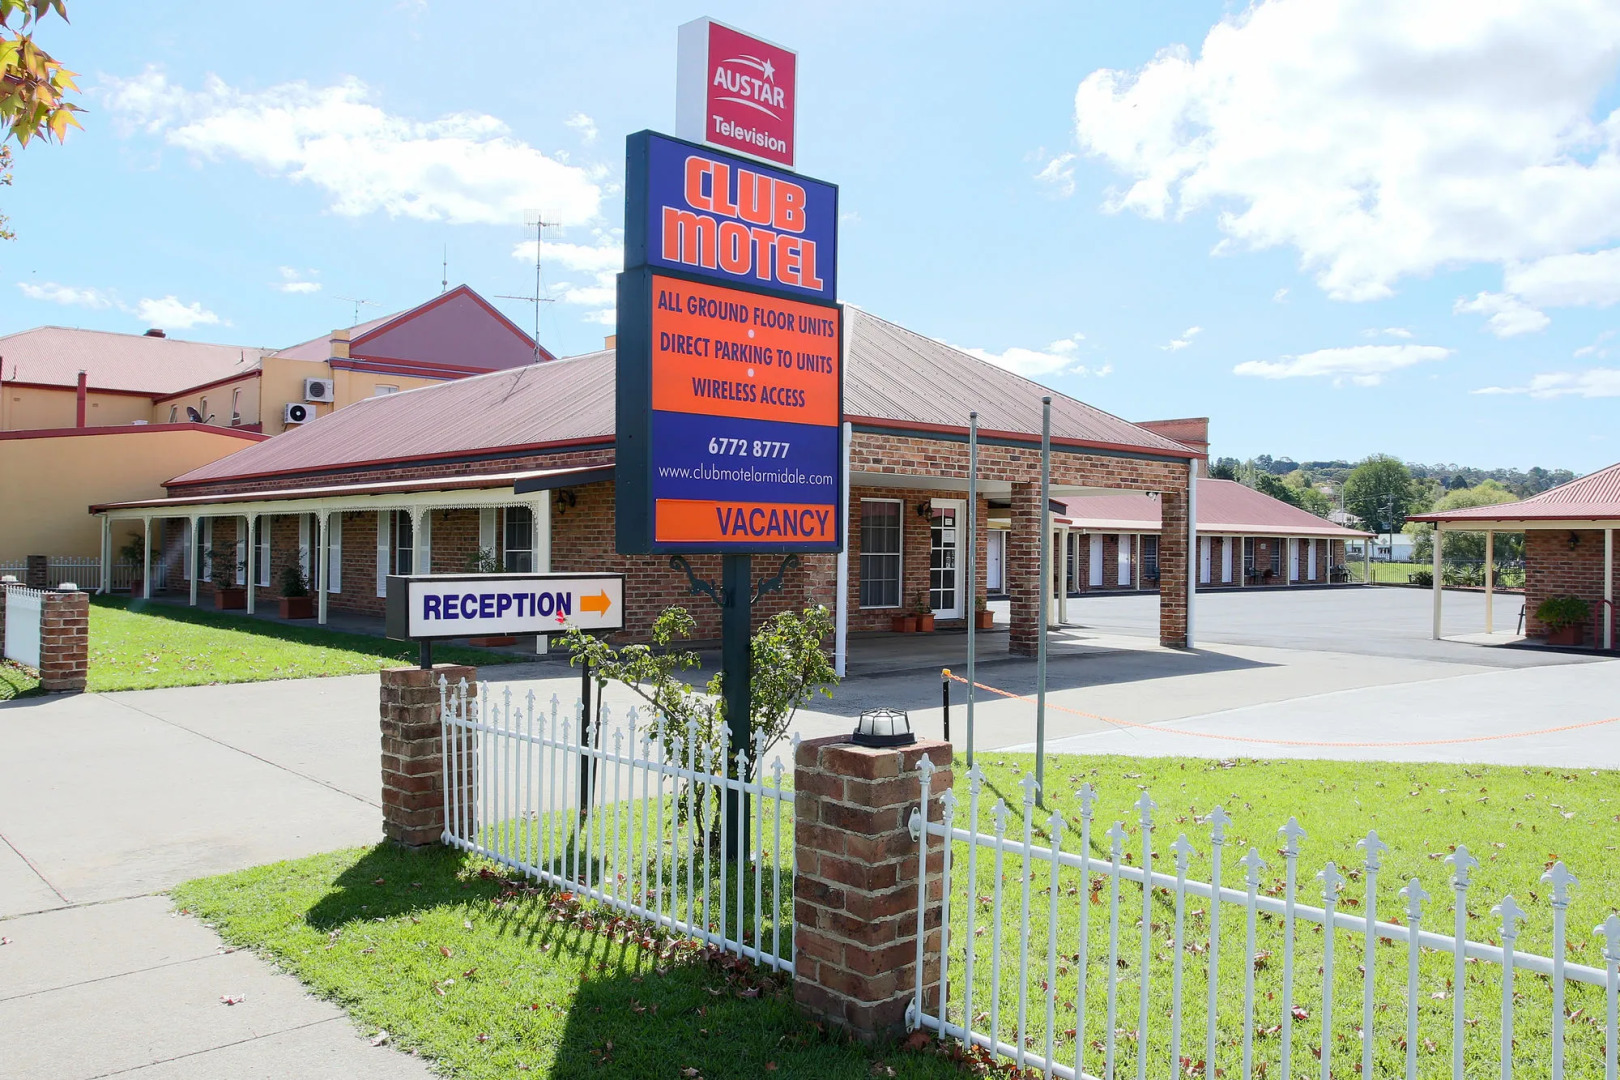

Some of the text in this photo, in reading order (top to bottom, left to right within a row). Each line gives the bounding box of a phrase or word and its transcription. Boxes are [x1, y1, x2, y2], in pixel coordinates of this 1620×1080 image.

[713, 66, 785, 109] AUSTAR
[713, 114, 786, 154] Television
[684, 155, 806, 234] CLUB
[662, 205, 823, 292] MOTEL
[657, 290, 834, 338] ALL GROUND FLOOR UNITS
[660, 332, 833, 375] DIRECT PARKING TO UNITS
[692, 377, 806, 408] WIRELESS ACCESS
[708, 437, 790, 459] 6772 8777
[658, 463, 833, 486] www.clubmotelarmidale.com
[716, 506, 829, 537] VACANCY
[423, 591, 572, 621] RECEPTION
